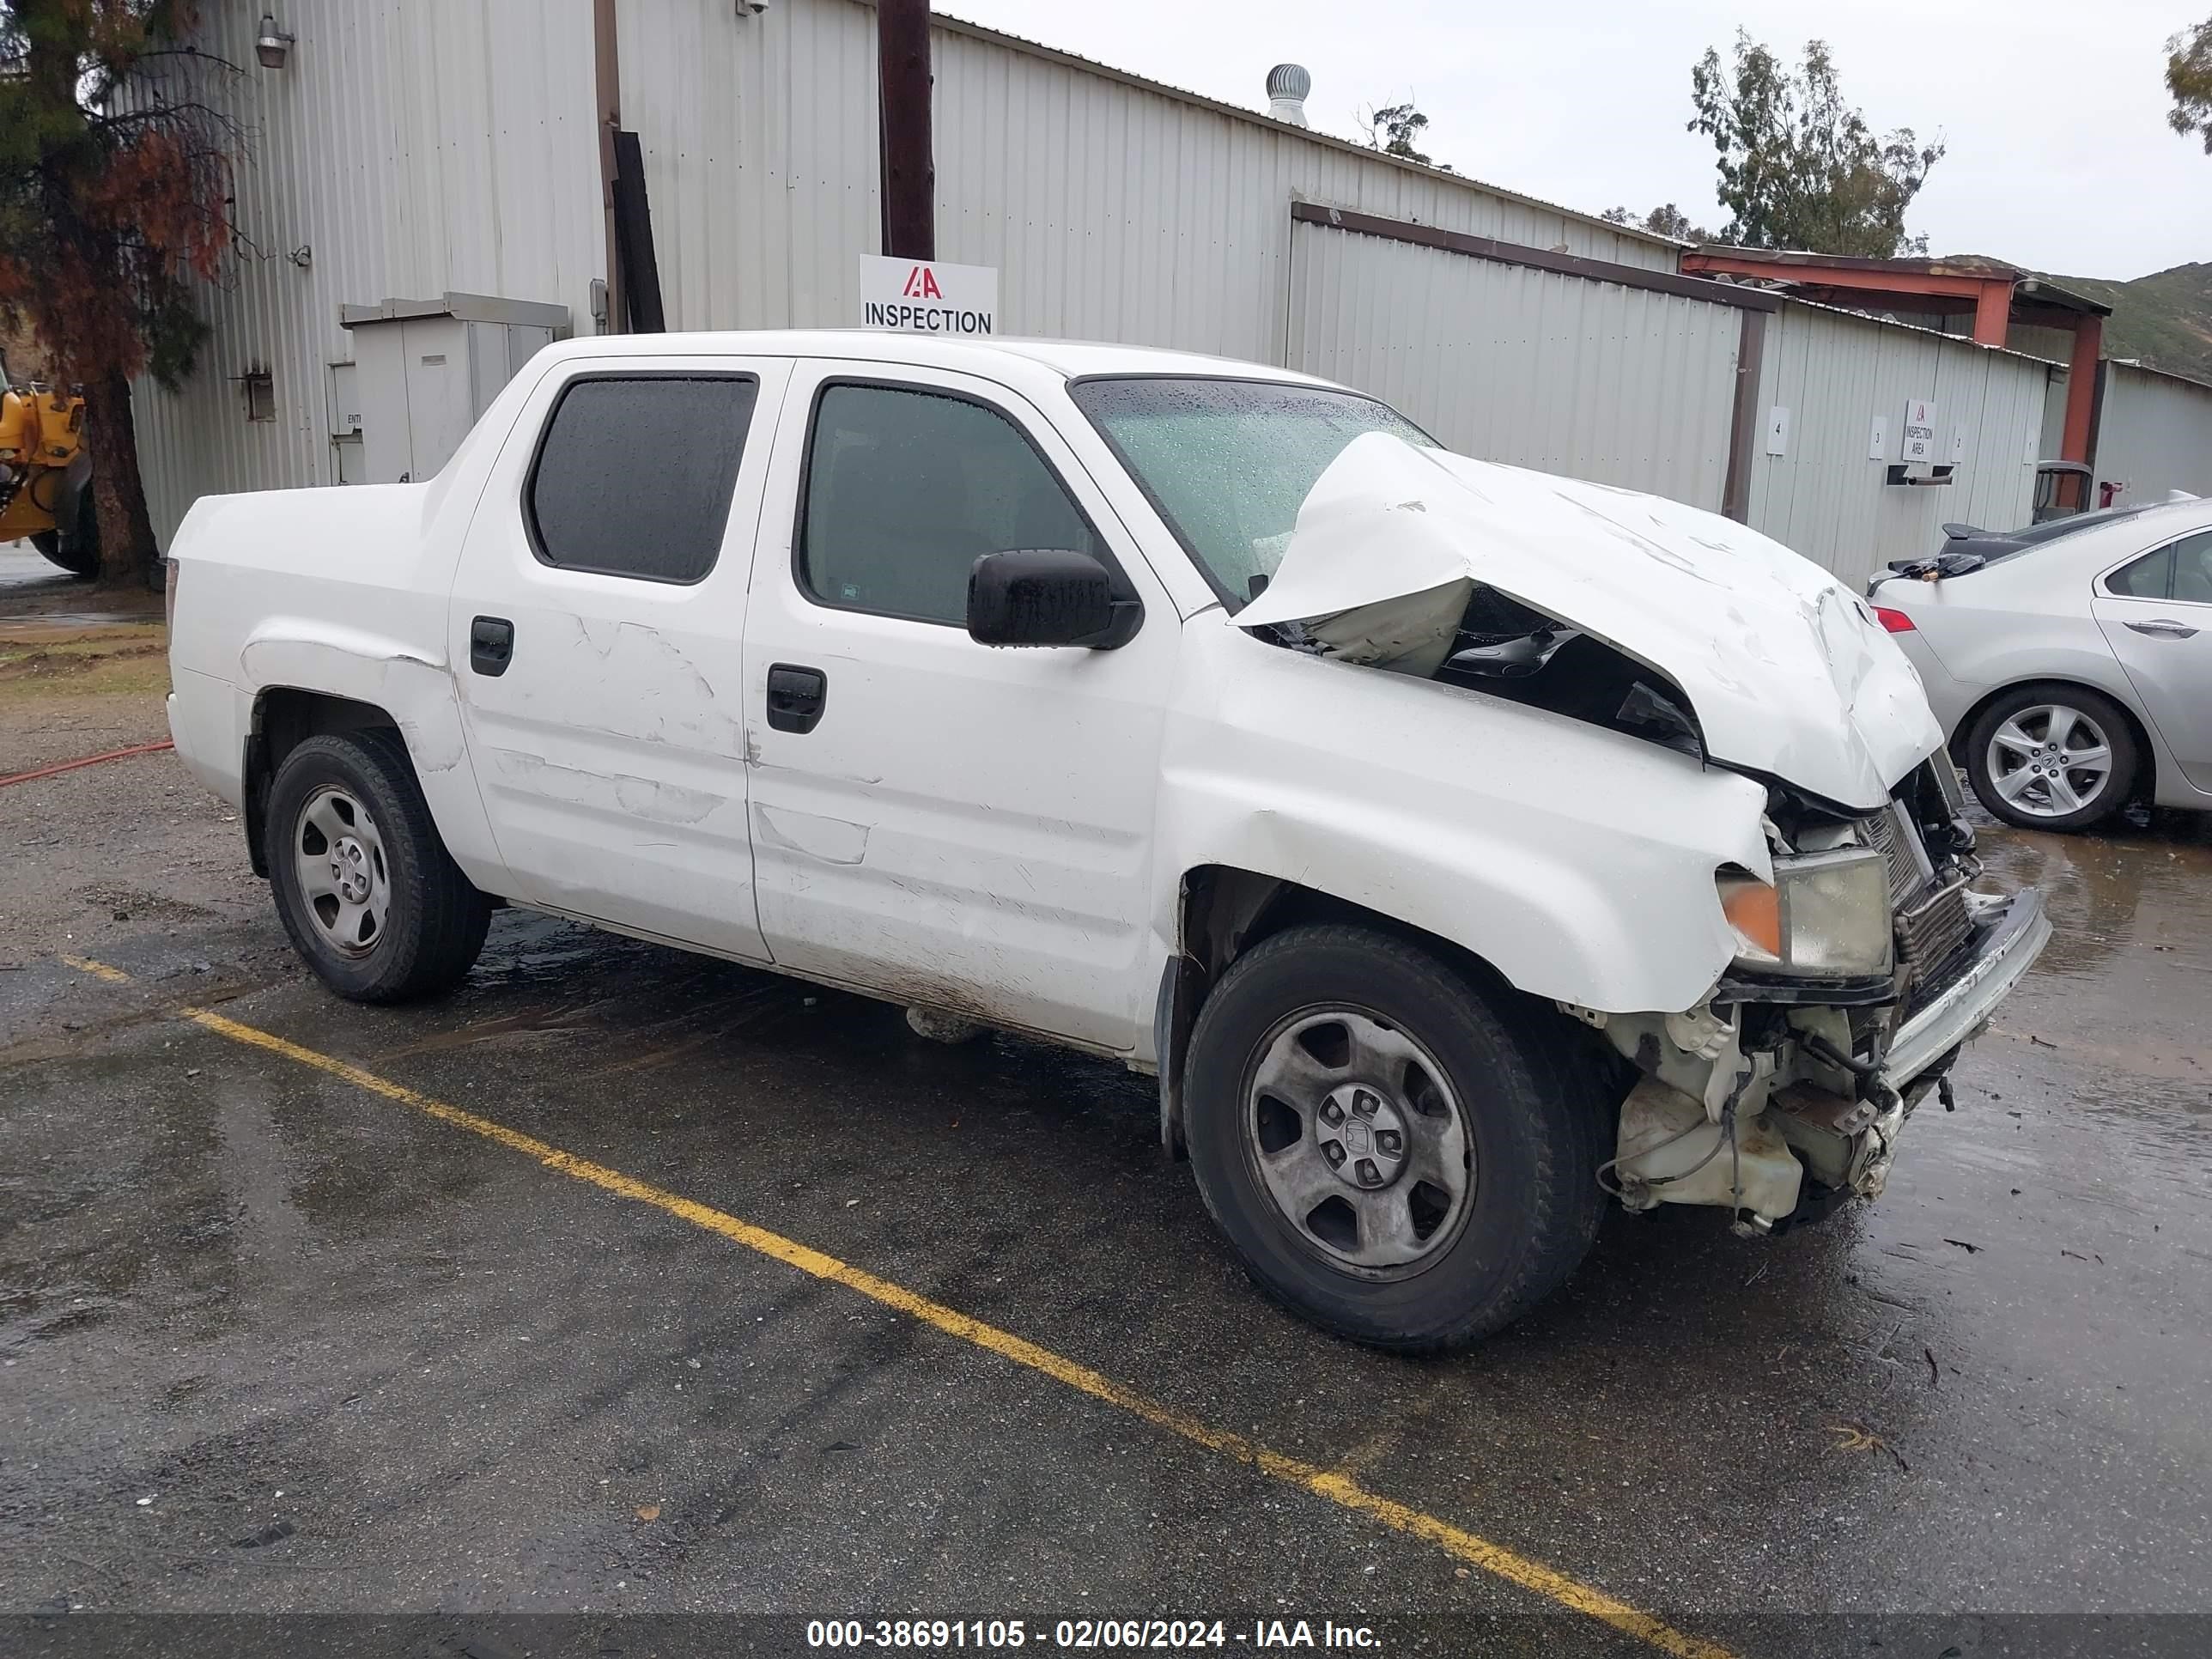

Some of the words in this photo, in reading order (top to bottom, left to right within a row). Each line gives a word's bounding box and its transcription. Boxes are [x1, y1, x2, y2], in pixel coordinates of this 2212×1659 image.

[866, 302, 991, 334] INSPECTION
[1775, 421, 1782, 435] 4
[1906, 425, 1933, 440] INSPECTION
[1875, 432, 1881, 444] 3
[1911, 441, 1924, 455] AREA
